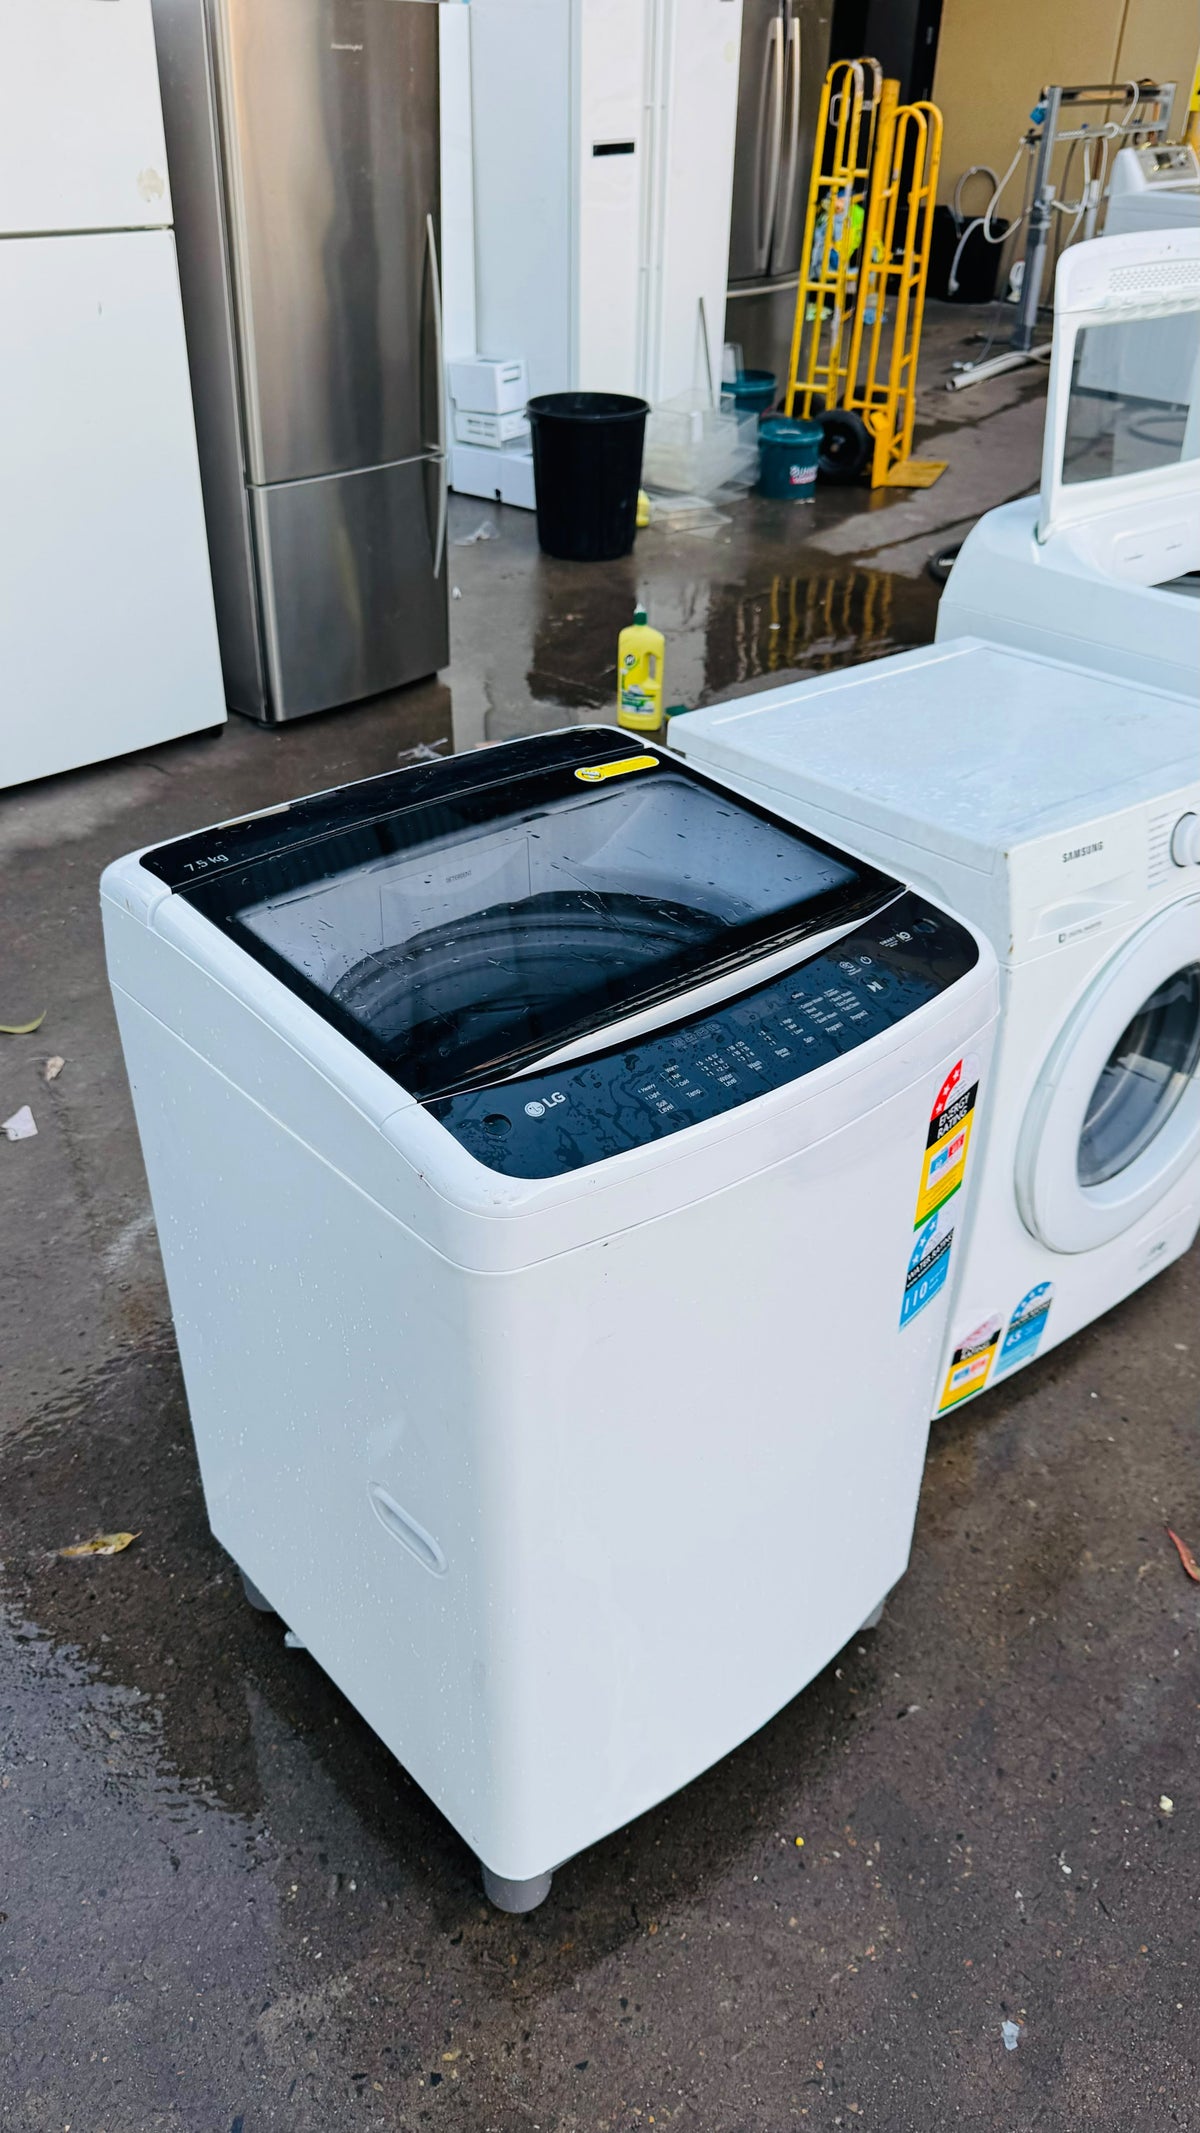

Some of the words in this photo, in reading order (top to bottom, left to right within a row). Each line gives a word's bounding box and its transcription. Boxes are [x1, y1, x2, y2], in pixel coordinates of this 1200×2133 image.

[183, 859, 209, 871] 7.5
[207, 854, 229, 863] kg
[1062, 841, 1104, 863] SAMSUNG
[541, 1091, 566, 1109] LG
[658, 1103, 675, 1115] Level
[939, 1091, 971, 1127] ENERGY
[937, 1107, 968, 1139] RATING
[907, 1255, 931, 1280] WATER
[904, 1281, 928, 1315] 110
